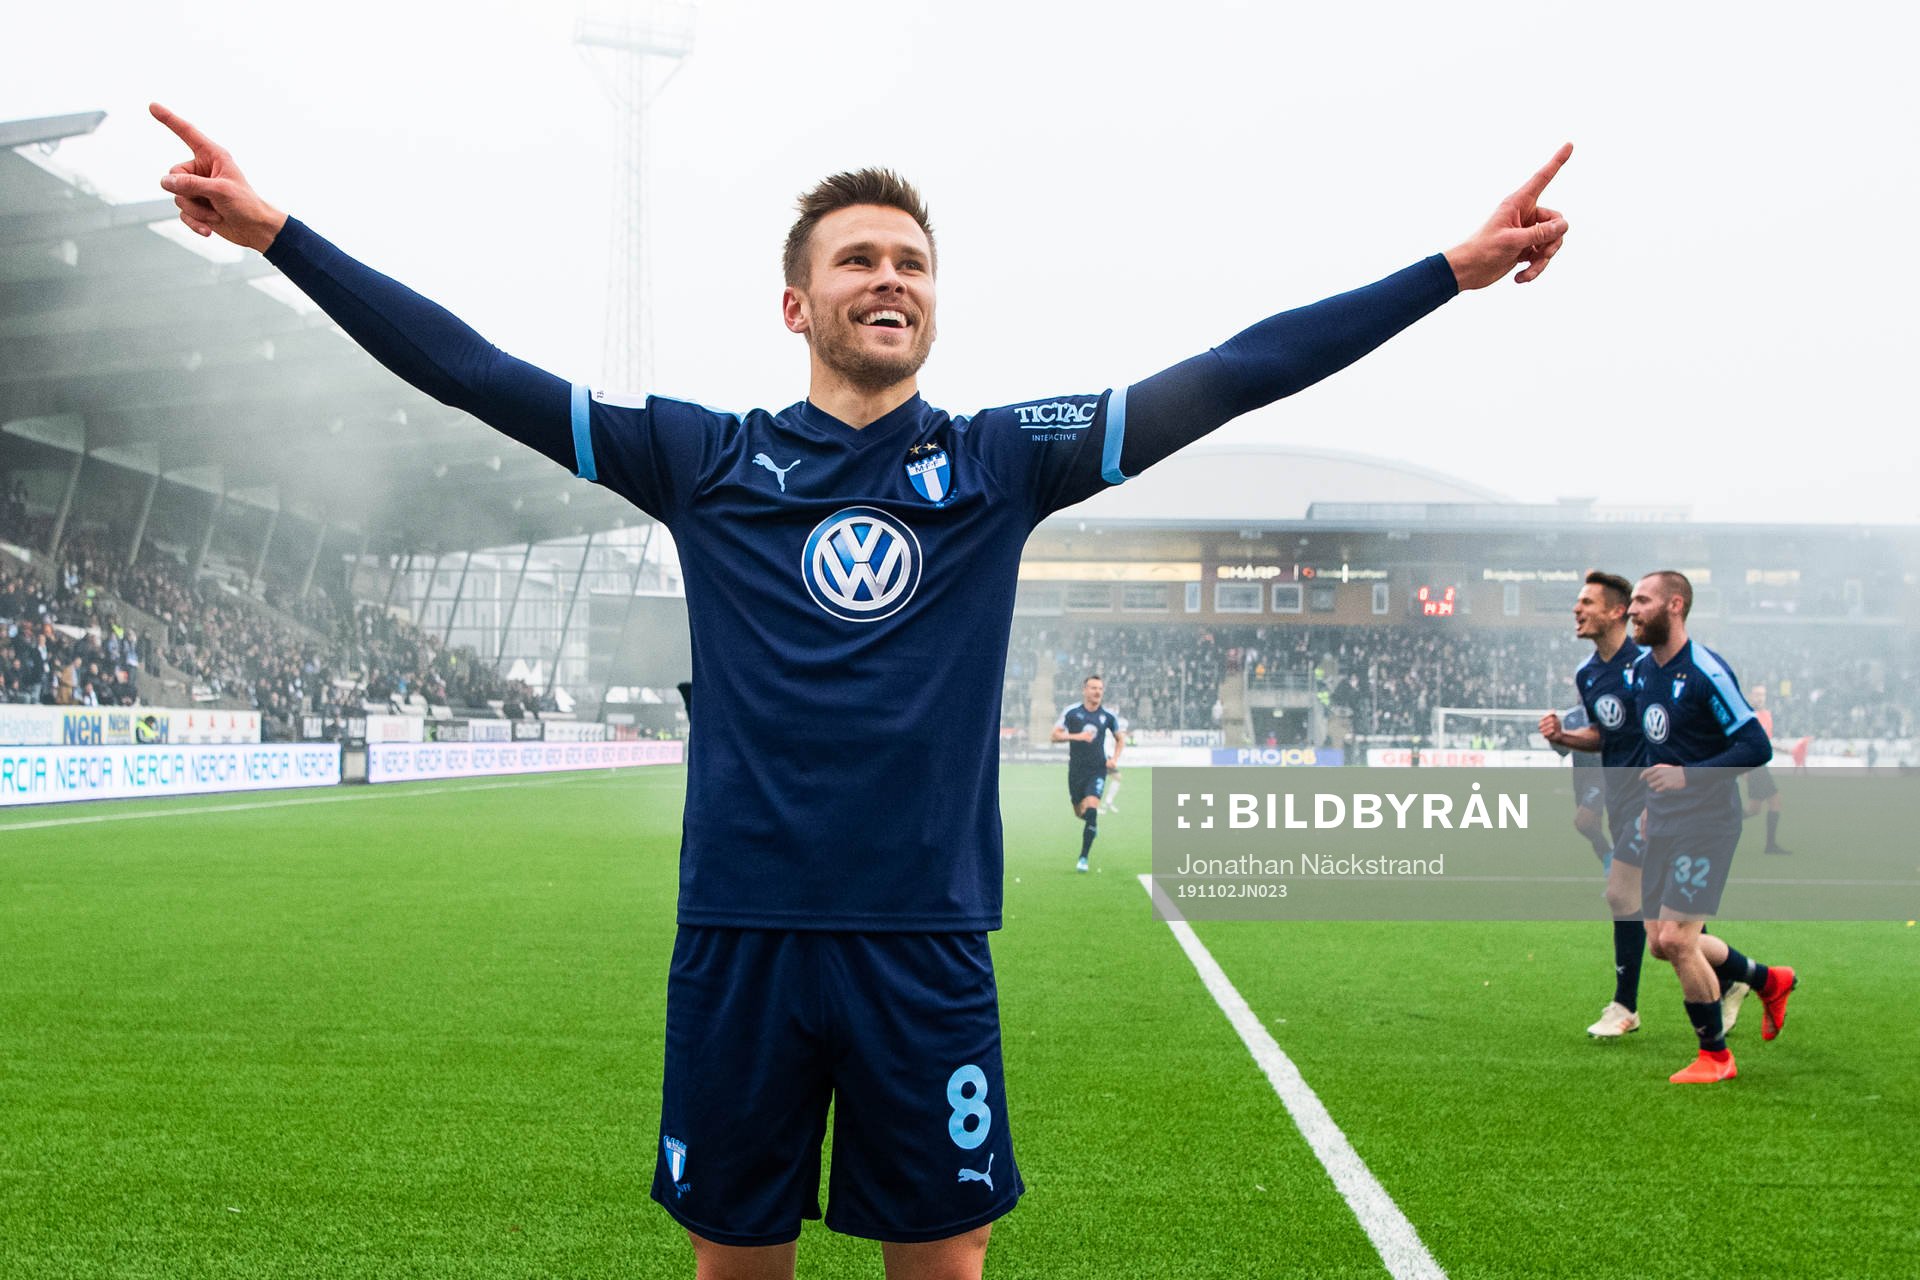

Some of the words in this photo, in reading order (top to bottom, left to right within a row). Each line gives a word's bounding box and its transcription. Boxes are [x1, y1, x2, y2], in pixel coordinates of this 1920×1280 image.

[1014, 402, 1098, 422] TICTAC
[1032, 433, 1077, 441] INTEACTIVE
[813, 517, 910, 607] VW
[56, 756, 112, 789] NERCIA
[123, 754, 183, 787] NERCIA
[192, 754, 236, 783] NERCIA
[1674, 855, 1711, 888] 32
[947, 1064, 991, 1149] 8
